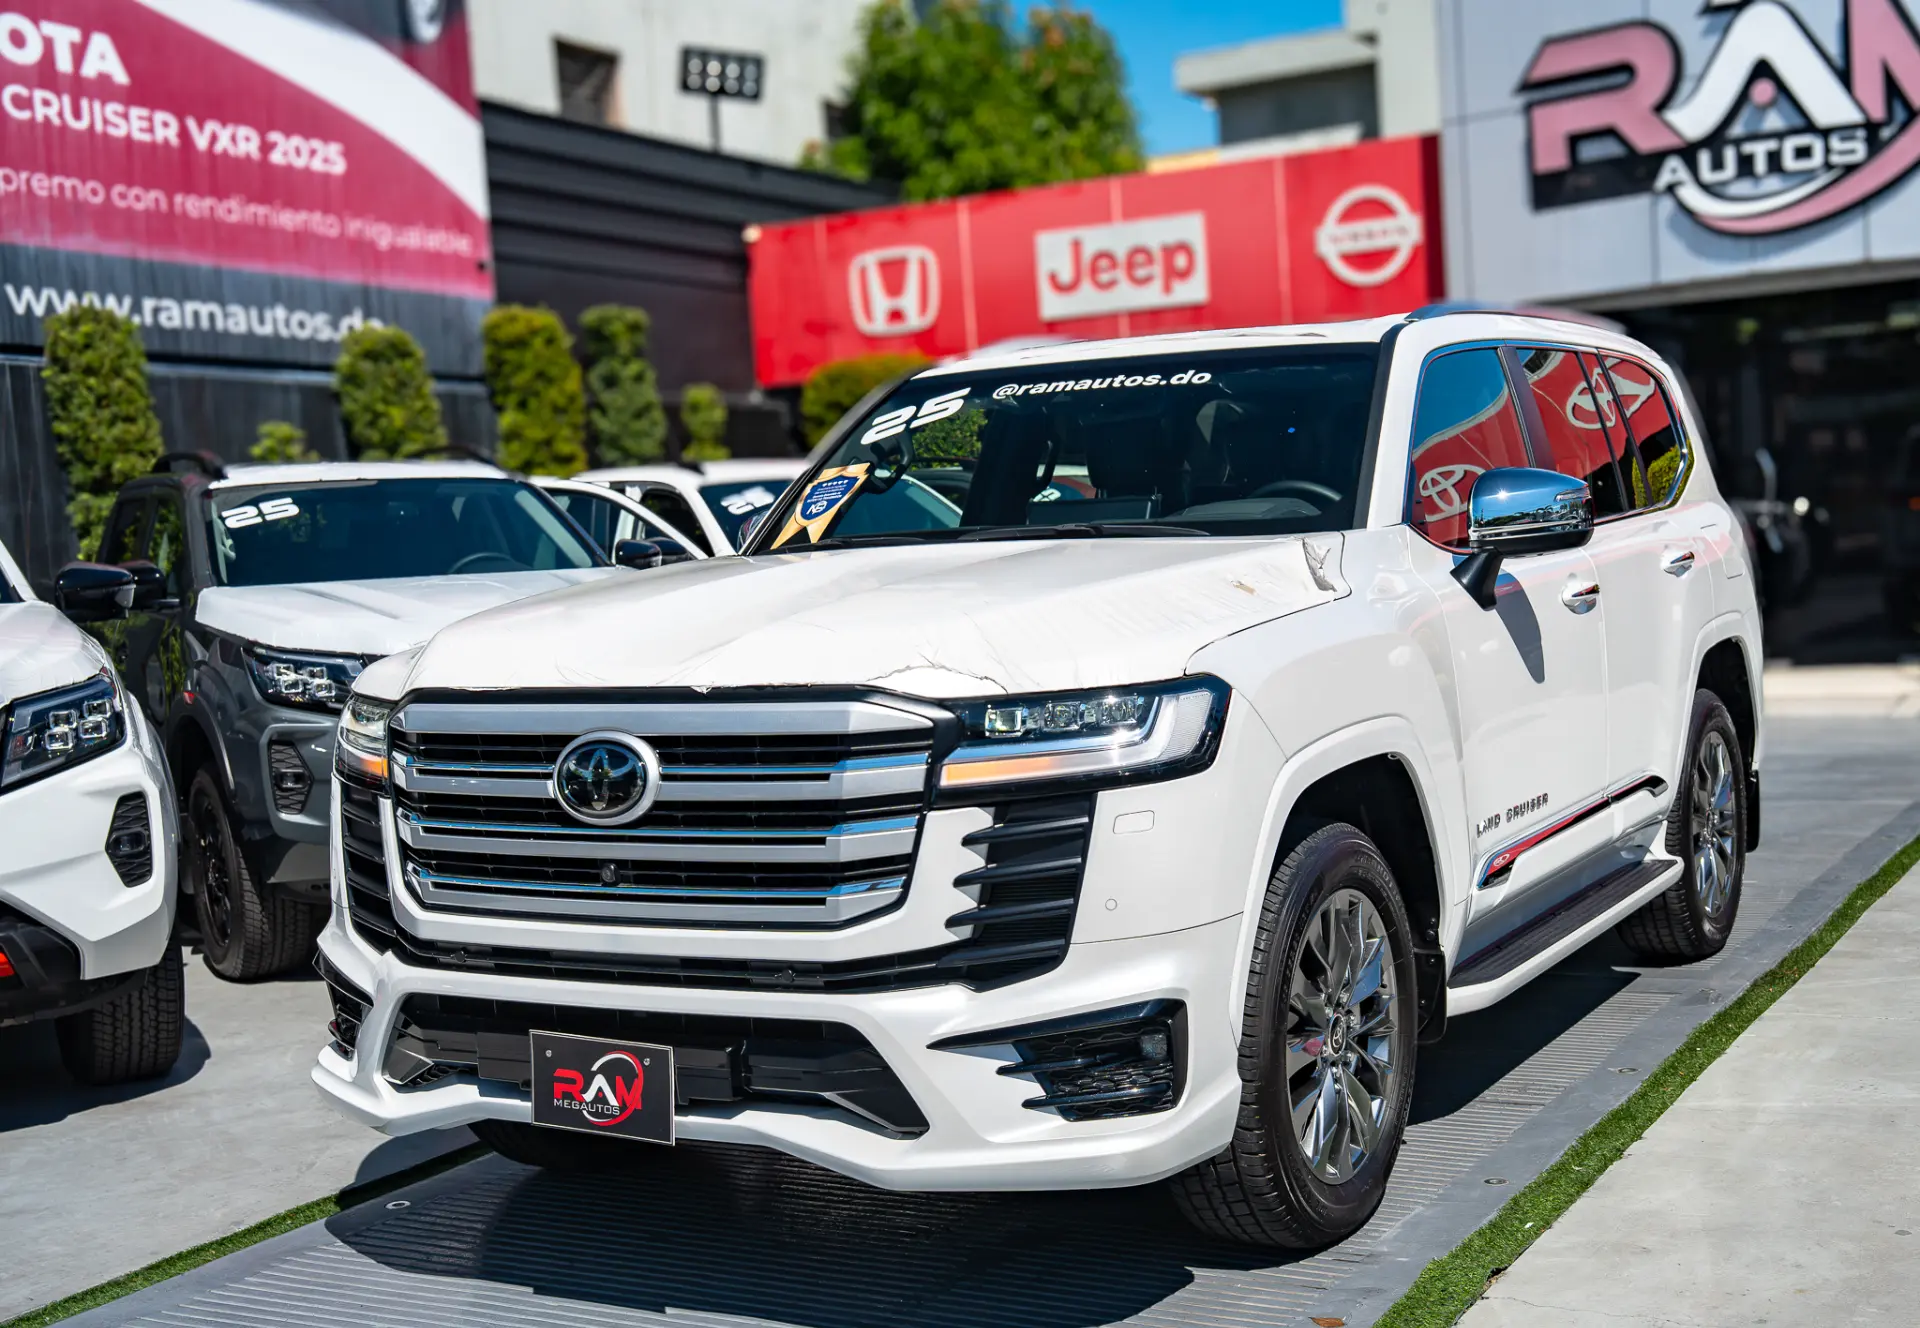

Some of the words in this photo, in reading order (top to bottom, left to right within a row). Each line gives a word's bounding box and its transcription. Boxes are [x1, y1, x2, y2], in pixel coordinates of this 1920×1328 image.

[0, 12, 131, 86] OTA
[2, 84, 181, 147] CRUISER
[185, 116, 261, 161] VXR
[266, 132, 347, 176] 2025
[1653, 130, 1869, 193] AUTOS
[110, 183, 169, 214] con
[1047, 237, 1195, 294] Jeep
[992, 369, 1212, 400] @ramautos.do
[861, 387, 971, 446] 25
[221, 497, 300, 529] 25
[1476, 813, 1501, 838] LAND
[1506, 792, 1549, 823] CRUISER
[553, 1068, 643, 1110] RAM
[553, 1098, 621, 1116] MEGAUTOS
